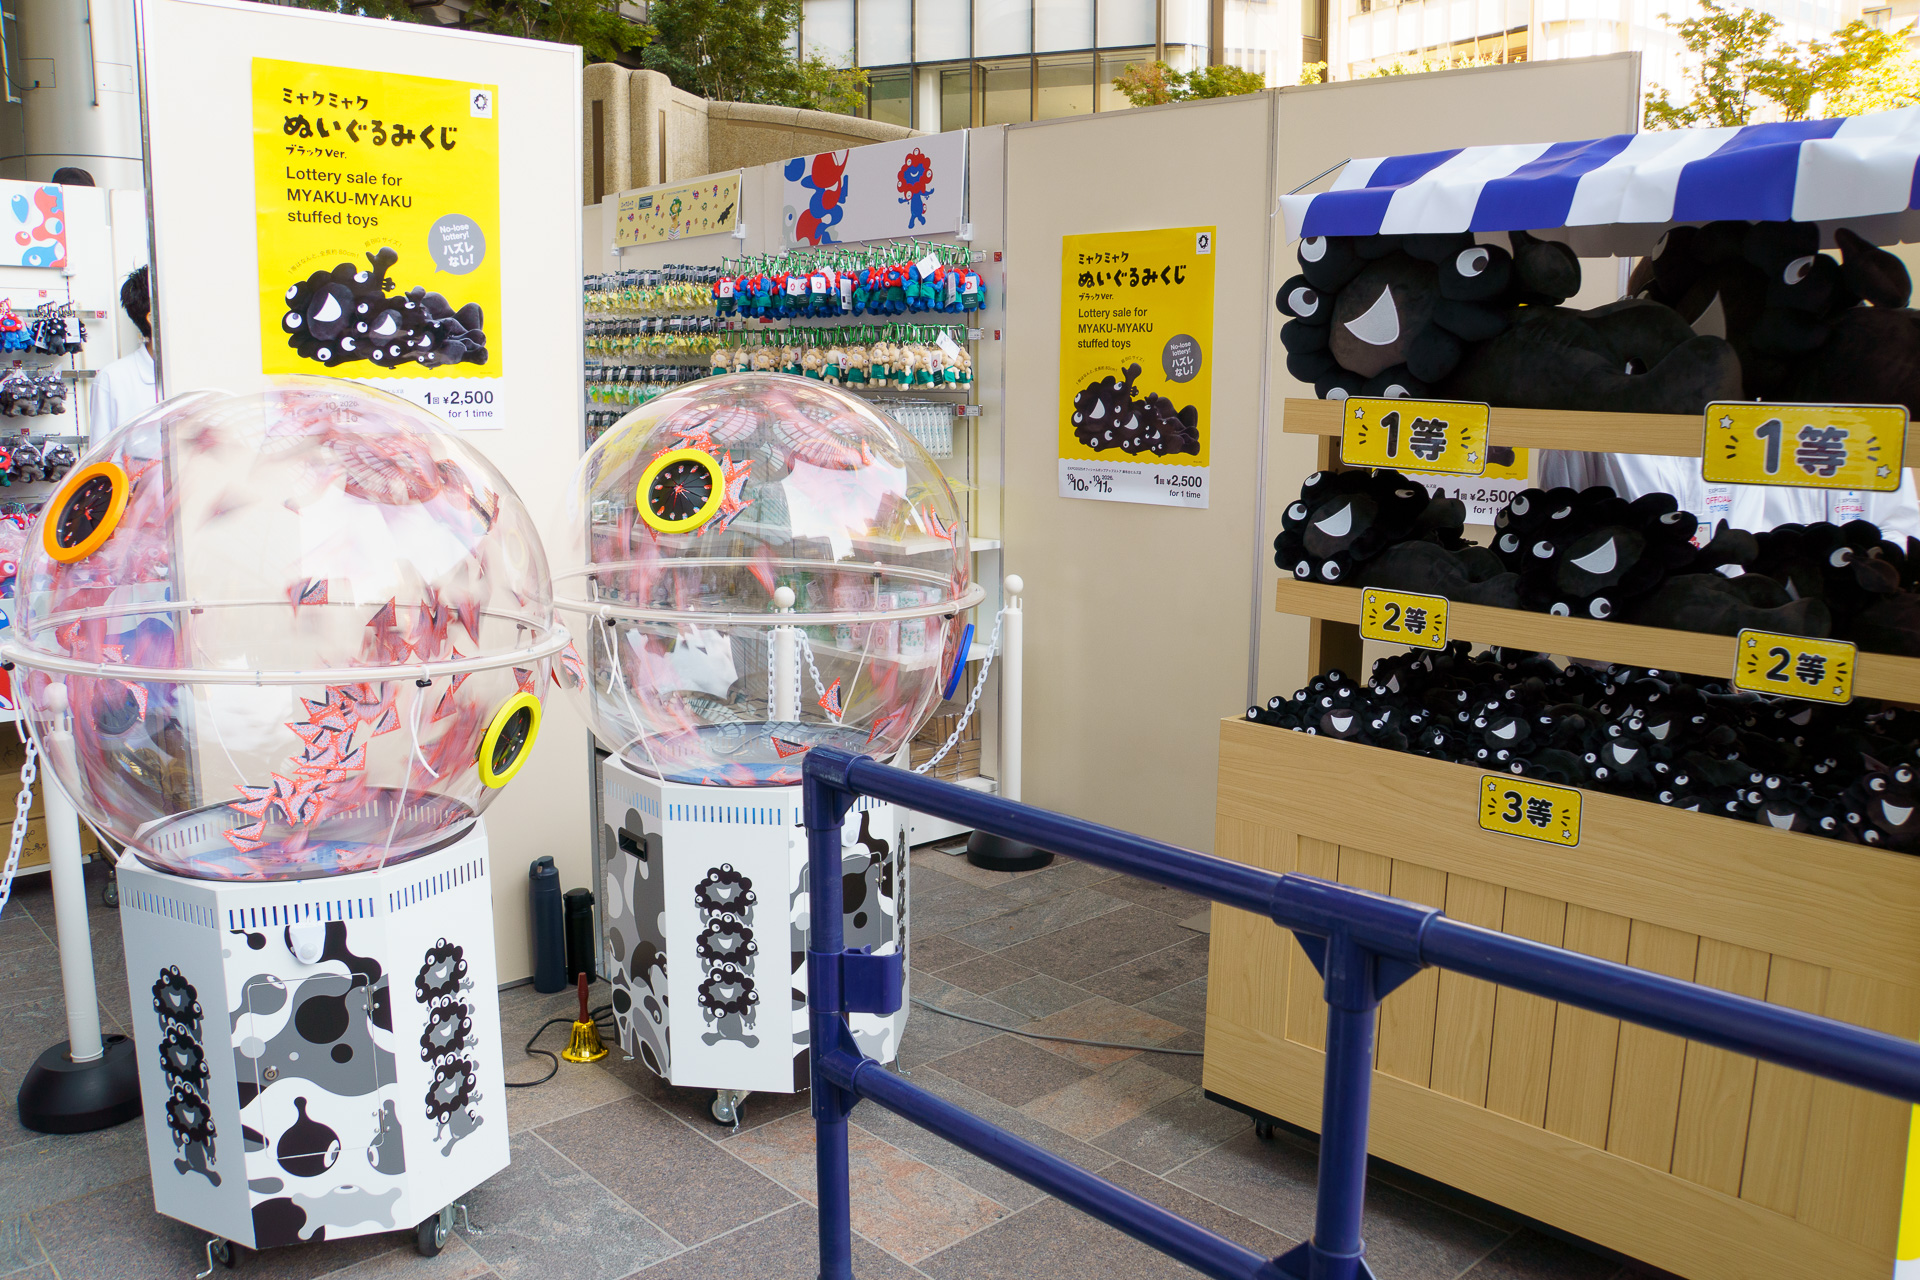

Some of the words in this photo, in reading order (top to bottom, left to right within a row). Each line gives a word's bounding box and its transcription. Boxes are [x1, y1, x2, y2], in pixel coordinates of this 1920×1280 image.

[282, 87, 368, 110] ミャクミャク
[283, 114, 457, 151] ぬいぐるみくじ
[286, 166, 341, 185] Lottery
[346, 172, 377, 185] sale
[381, 174, 402, 186] for
[287, 188, 412, 208] MYAKU-MYAKU
[287, 211, 341, 224] stuffed
[346, 213, 379, 228] toys
[439, 223, 469, 234] No-lose
[442, 231, 469, 241] lottery!
[443, 242, 474, 255] ハズレ
[448, 253, 474, 268] なし!
[1078, 251, 1129, 265] ミャクミャク
[1078, 265, 1187, 288] ぬいぐるみくじ
[1078, 308, 1110, 319] Lottery
[1112, 308, 1132, 318] sale
[1134, 307, 1148, 317] for
[1078, 322, 1153, 333] MYAKU-MYAKU
[1077, 338, 1109, 348] stuffed
[1111, 339, 1131, 350] toys
[1170, 341, 1191, 351] No-lose
[1172, 347, 1192, 357] lottery!
[1171, 358, 1194, 368] ハズレ
[1174, 365, 1193, 377] なし!
[443, 390, 494, 406] ¥2,500
[448, 409, 463, 418] for
[465, 409, 470, 418] 1
[472, 409, 494, 418] time
[1380, 410, 1449, 462] 1等
[1755, 418, 1849, 477] 1等
[1166, 474, 1203, 488] ¥2,500
[1169, 489, 1179, 497] for
[1186, 490, 1201, 498] time
[1473, 506, 1486, 514] for
[1709, 503, 1729, 513] STORE
[1382, 602, 1428, 635] 2等
[1765, 646, 1828, 686] 2等
[1502, 790, 1553, 828] 3等
